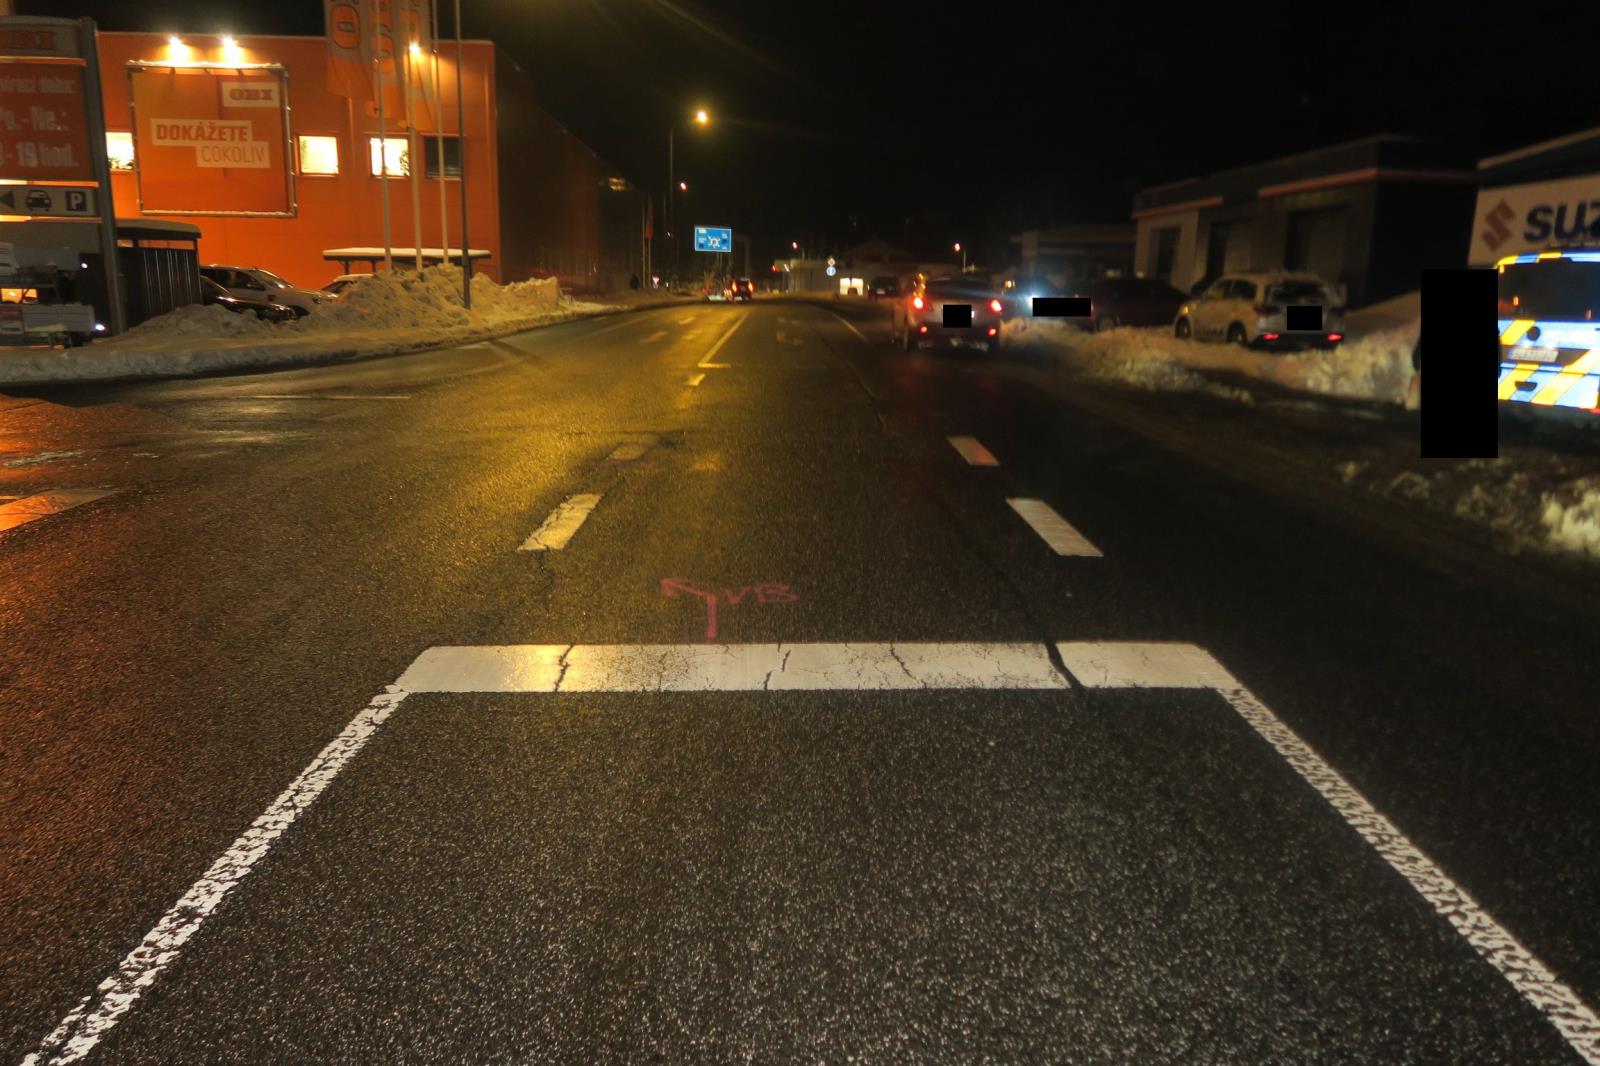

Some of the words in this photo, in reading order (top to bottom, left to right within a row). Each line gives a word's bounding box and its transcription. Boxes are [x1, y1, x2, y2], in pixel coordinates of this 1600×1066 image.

[157, 121, 248, 142] DOKÁŽETE
[16, 141, 39, 168] 19
[201, 146, 264, 163] COKOLIV
